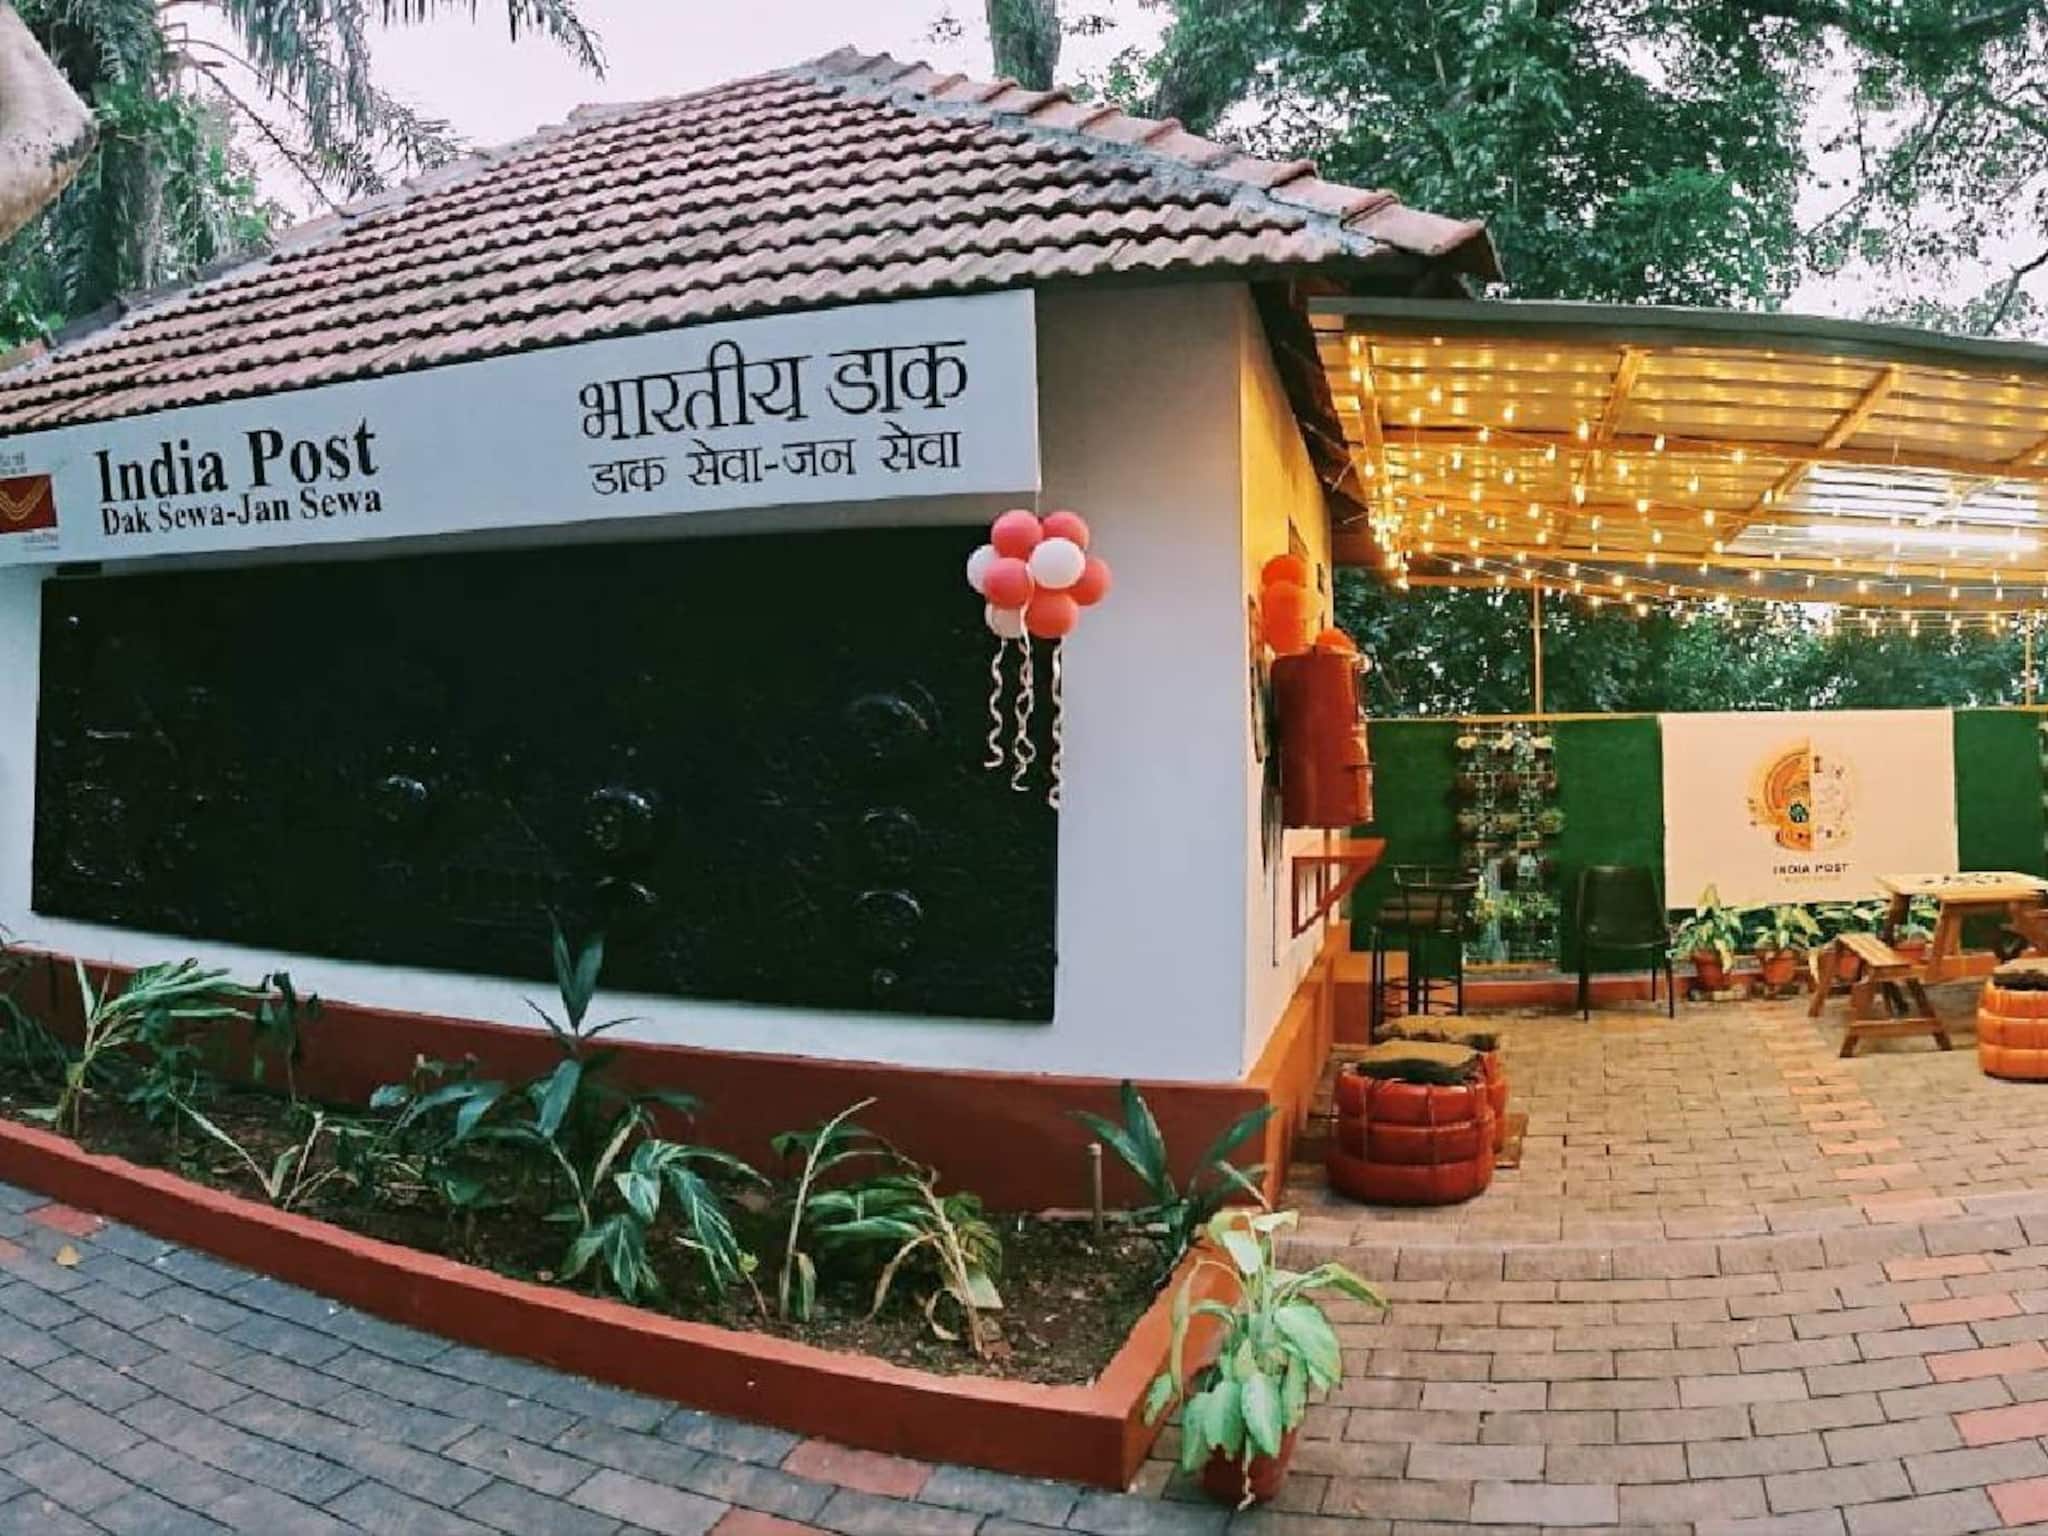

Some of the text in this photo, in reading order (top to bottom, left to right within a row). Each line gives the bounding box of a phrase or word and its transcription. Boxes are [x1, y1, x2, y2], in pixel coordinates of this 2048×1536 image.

[578, 340, 968, 441] भारतीय डाक
[94, 416, 380, 503] India Post
[588, 422, 963, 496] डाक सेवा-जन सेवा
[101, 487, 383, 537] Dak Sewa-Jan Sewa
[1773, 863, 1849, 875] INDIA POST
